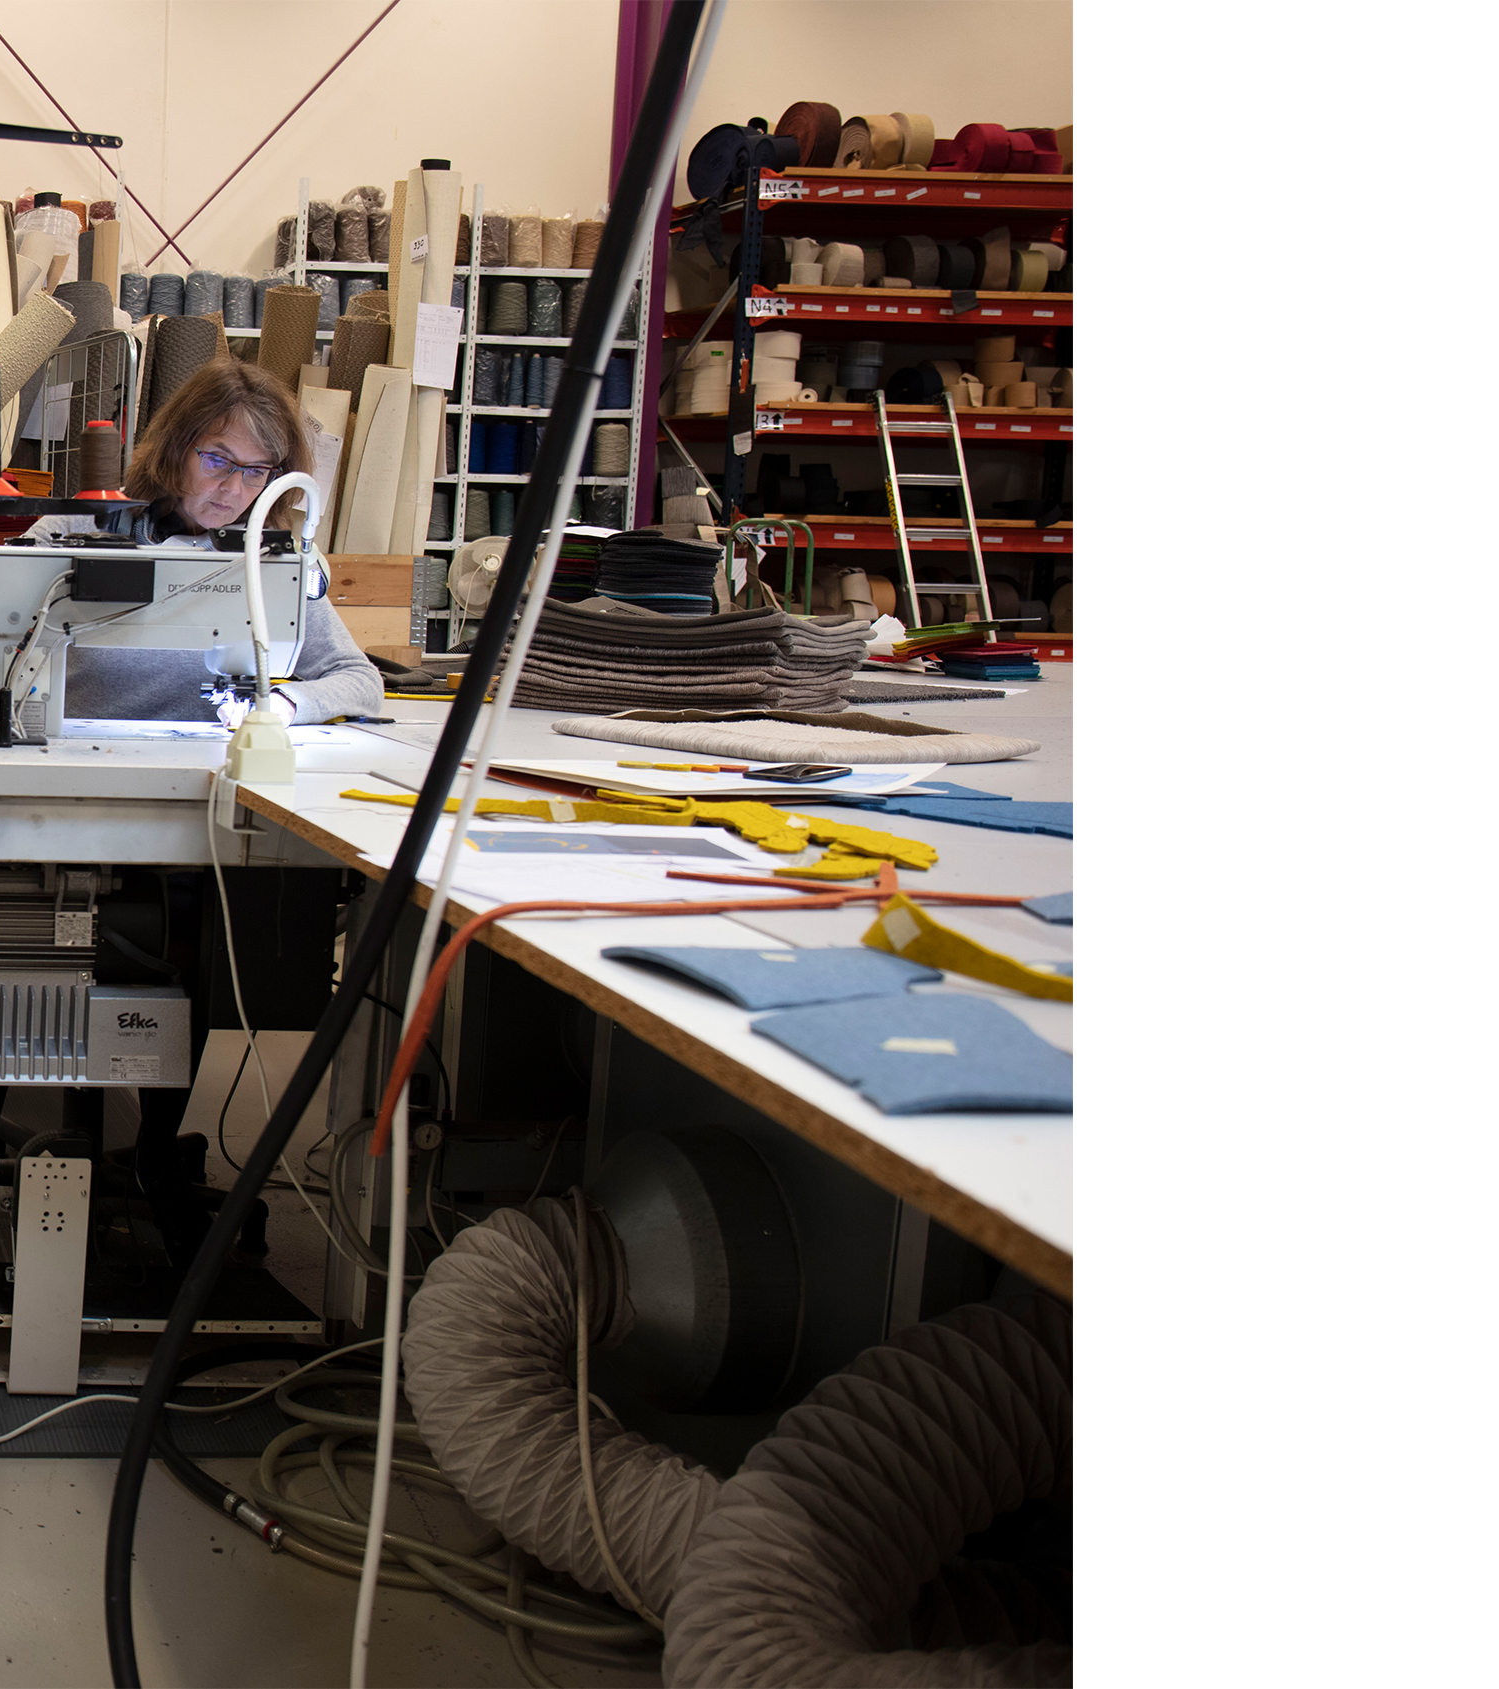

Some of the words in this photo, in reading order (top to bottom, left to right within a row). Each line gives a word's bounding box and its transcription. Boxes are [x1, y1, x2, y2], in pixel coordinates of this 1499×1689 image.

[764, 182, 788, 199] N5
[750, 298, 773, 314] N4
[211, 584, 242, 593] ADLER
[117, 1012, 158, 1029] Efka
